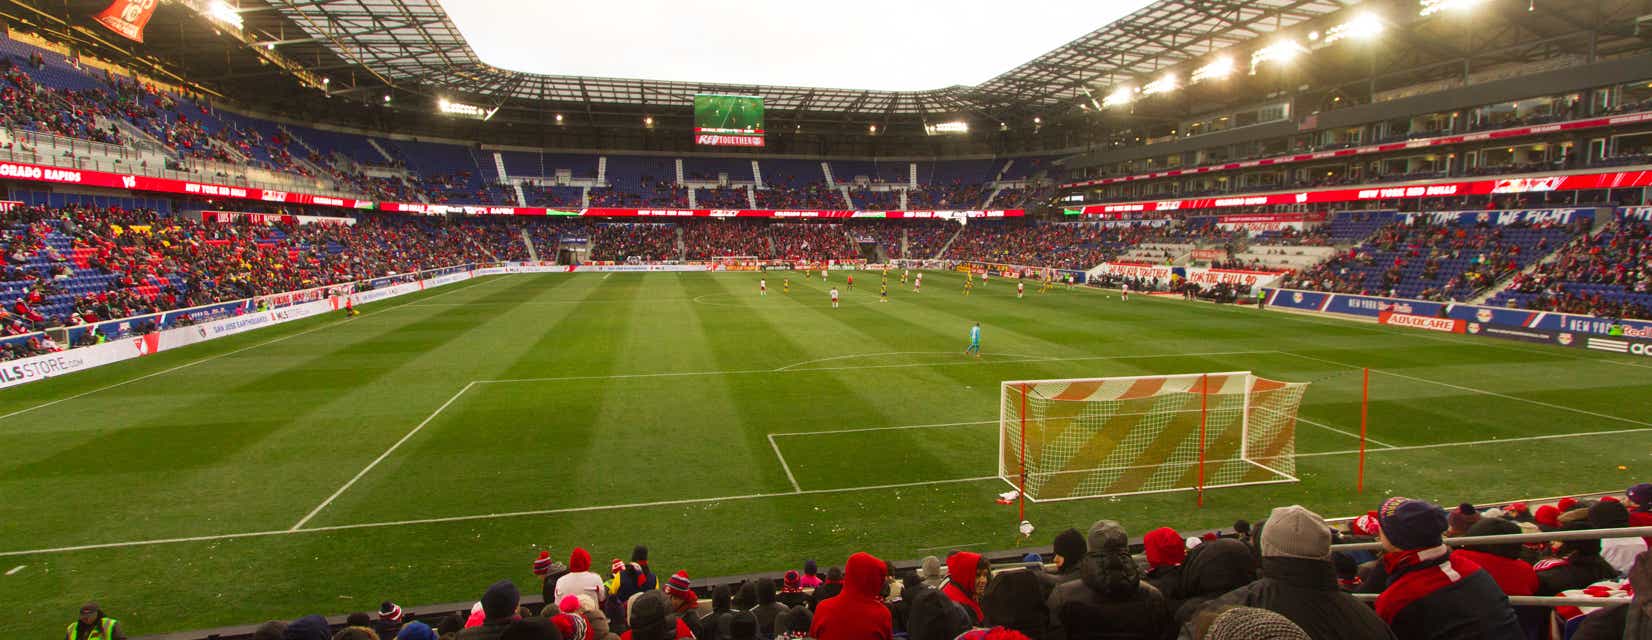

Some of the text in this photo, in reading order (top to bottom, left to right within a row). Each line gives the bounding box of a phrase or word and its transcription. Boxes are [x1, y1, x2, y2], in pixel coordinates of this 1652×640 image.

[720, 135, 752, 145] TOGETHER
[44, 169, 81, 182] RAPIDS
[185, 182, 200, 192] NEW
[202, 184, 218, 195] YORK
[1358, 185, 1456, 199] NEW YORK RED BULLS
[1496, 208, 1576, 225] WE FIGHT
[1348, 298, 1360, 308] NEW
[1362, 299, 1377, 310] YORK
[1391, 315, 1452, 330] ADVOCARE
[1570, 319, 1590, 332] NEW
